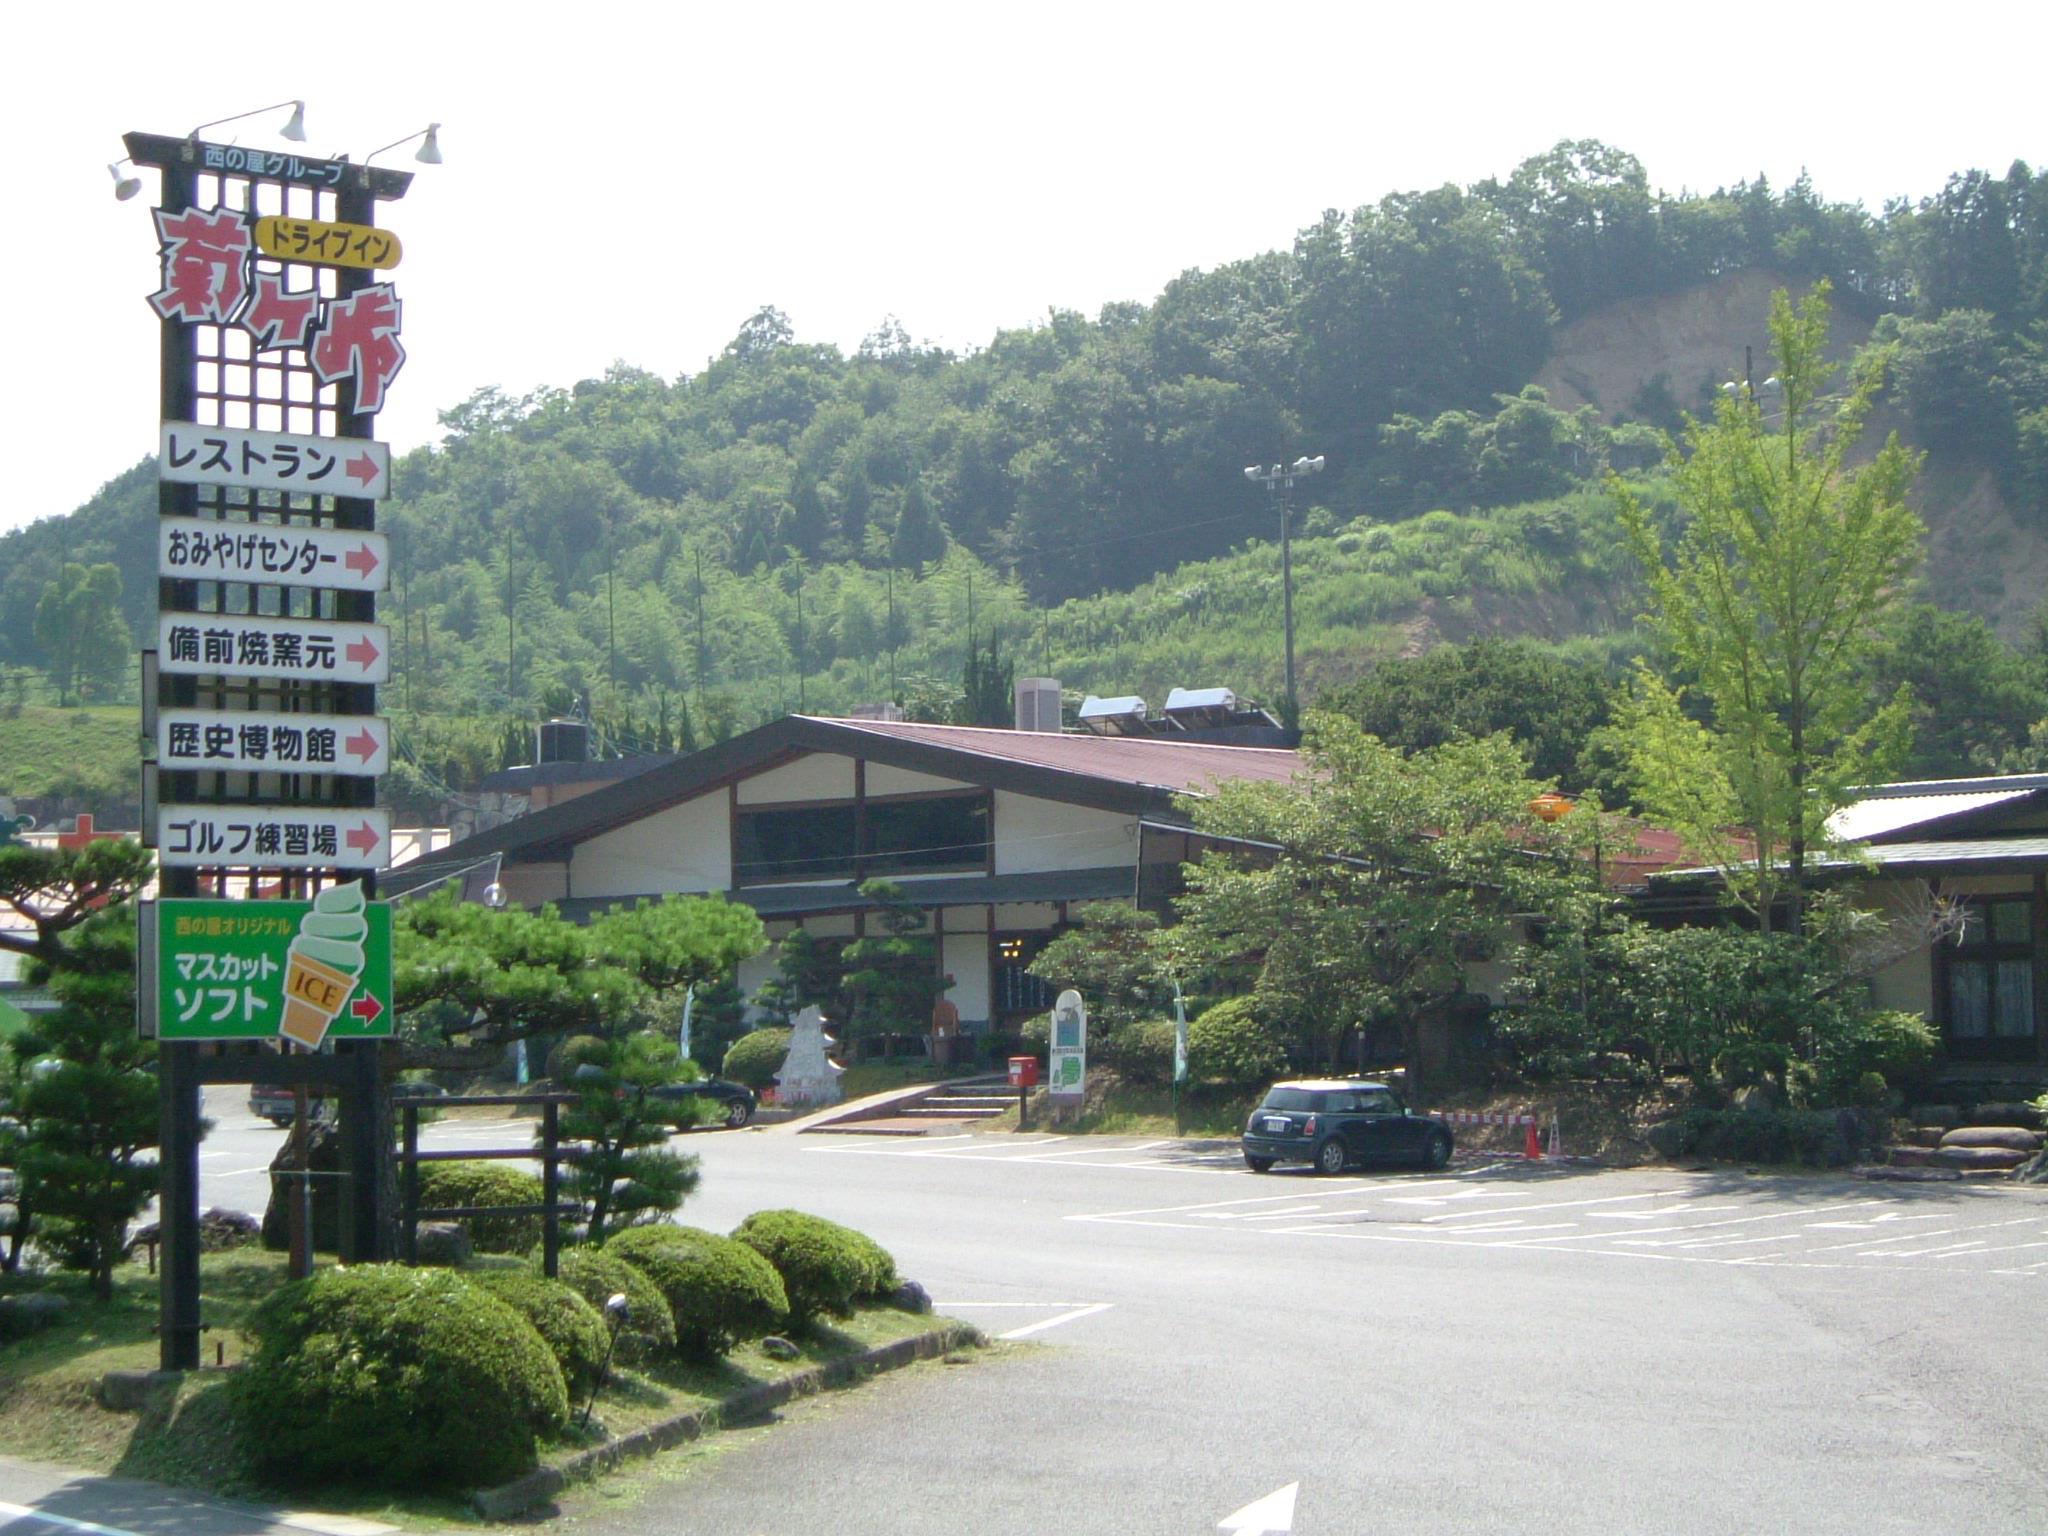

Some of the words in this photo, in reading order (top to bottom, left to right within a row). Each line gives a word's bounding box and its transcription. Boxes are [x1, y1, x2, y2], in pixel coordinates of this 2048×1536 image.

[273, 221, 390, 264] ドライブイン
[169, 434, 336, 480] レストラン
[168, 529, 337, 575] おみやげセンター
[168, 625, 336, 669] 備前焼窯元
[168, 722, 337, 763] 歴史博物館
[168, 819, 338, 858] ゴルフ練習場
[175, 952, 279, 981] マスカット
[175, 986, 268, 1022] ソフト
[294, 971, 339, 1008] ICE
